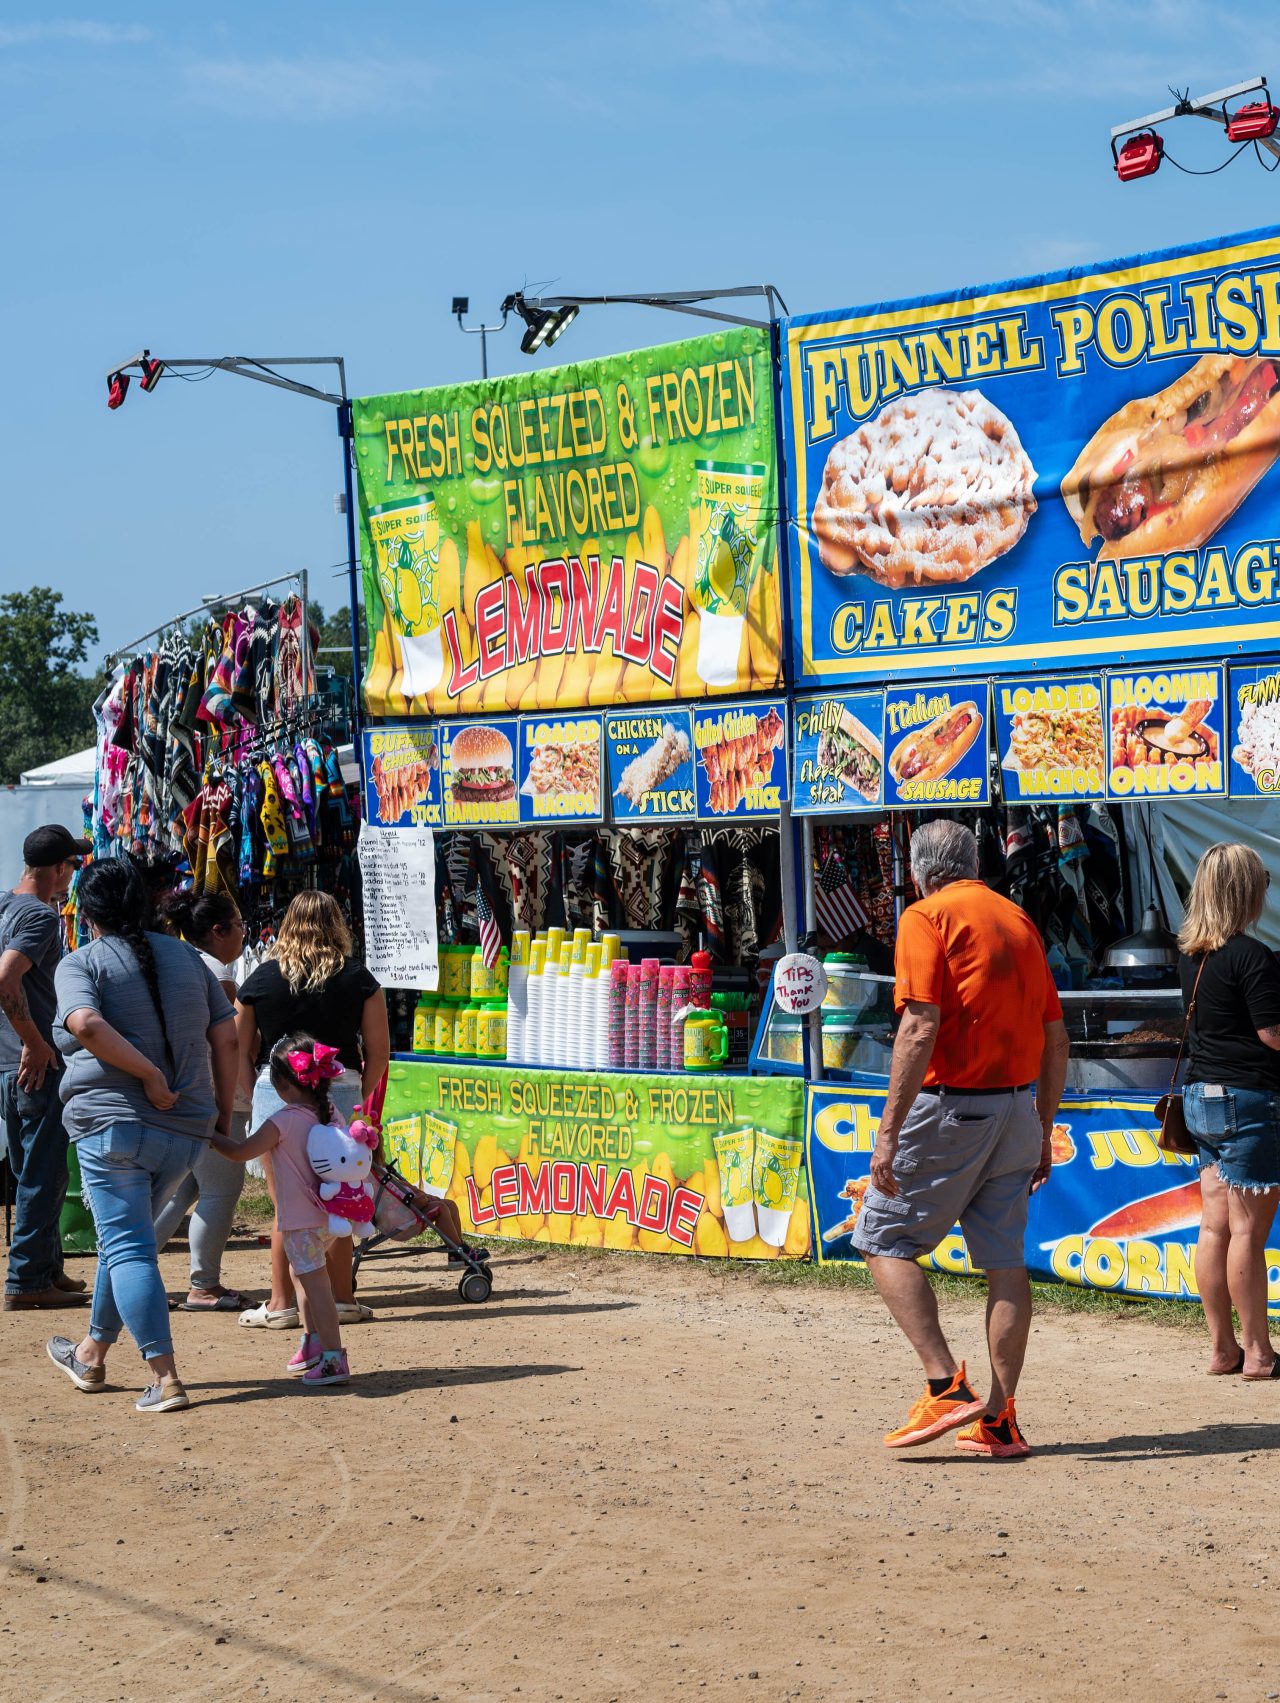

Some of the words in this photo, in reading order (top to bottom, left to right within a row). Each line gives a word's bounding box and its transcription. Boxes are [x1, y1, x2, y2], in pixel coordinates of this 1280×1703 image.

[804, 311, 1045, 445] FUNNEL
[385, 408, 463, 483] FRESH
[472, 388, 608, 472] SQUEEZED
[618, 383, 639, 451] &
[647, 357, 756, 446] FROZEN
[503, 460, 641, 545] FLAVORED
[443, 556, 685, 699] LEMONADE
[830, 588, 1018, 653] CAKES
[1001, 684, 1099, 715] LOADED
[1110, 671, 1218, 707] BLOOMIN
[525, 719, 600, 748] LOADED
[608, 717, 664, 741] CHICKEN
[723, 708, 758, 744] Chicken
[371, 731, 434, 756] BUFFALO
[382, 748, 429, 772] CHICKEN
[616, 744, 630, 755] ON
[631, 744, 640, 755] A
[902, 777, 983, 802] SAUSAGE
[1017, 767, 1102, 796] NACHOS
[1108, 760, 1224, 795] ONION
[411, 804, 441, 824] STICK
[639, 790, 695, 815] STICK
[744, 786, 781, 810] STICK
[438, 1076, 502, 1115] FRESH
[511, 1080, 616, 1120] SQUEEZED
[625, 1087, 639, 1120] &
[649, 1088, 735, 1125] FROZEN
[528, 1120, 634, 1160] FLAVORED
[466, 1161, 705, 1247] LEMONADE
